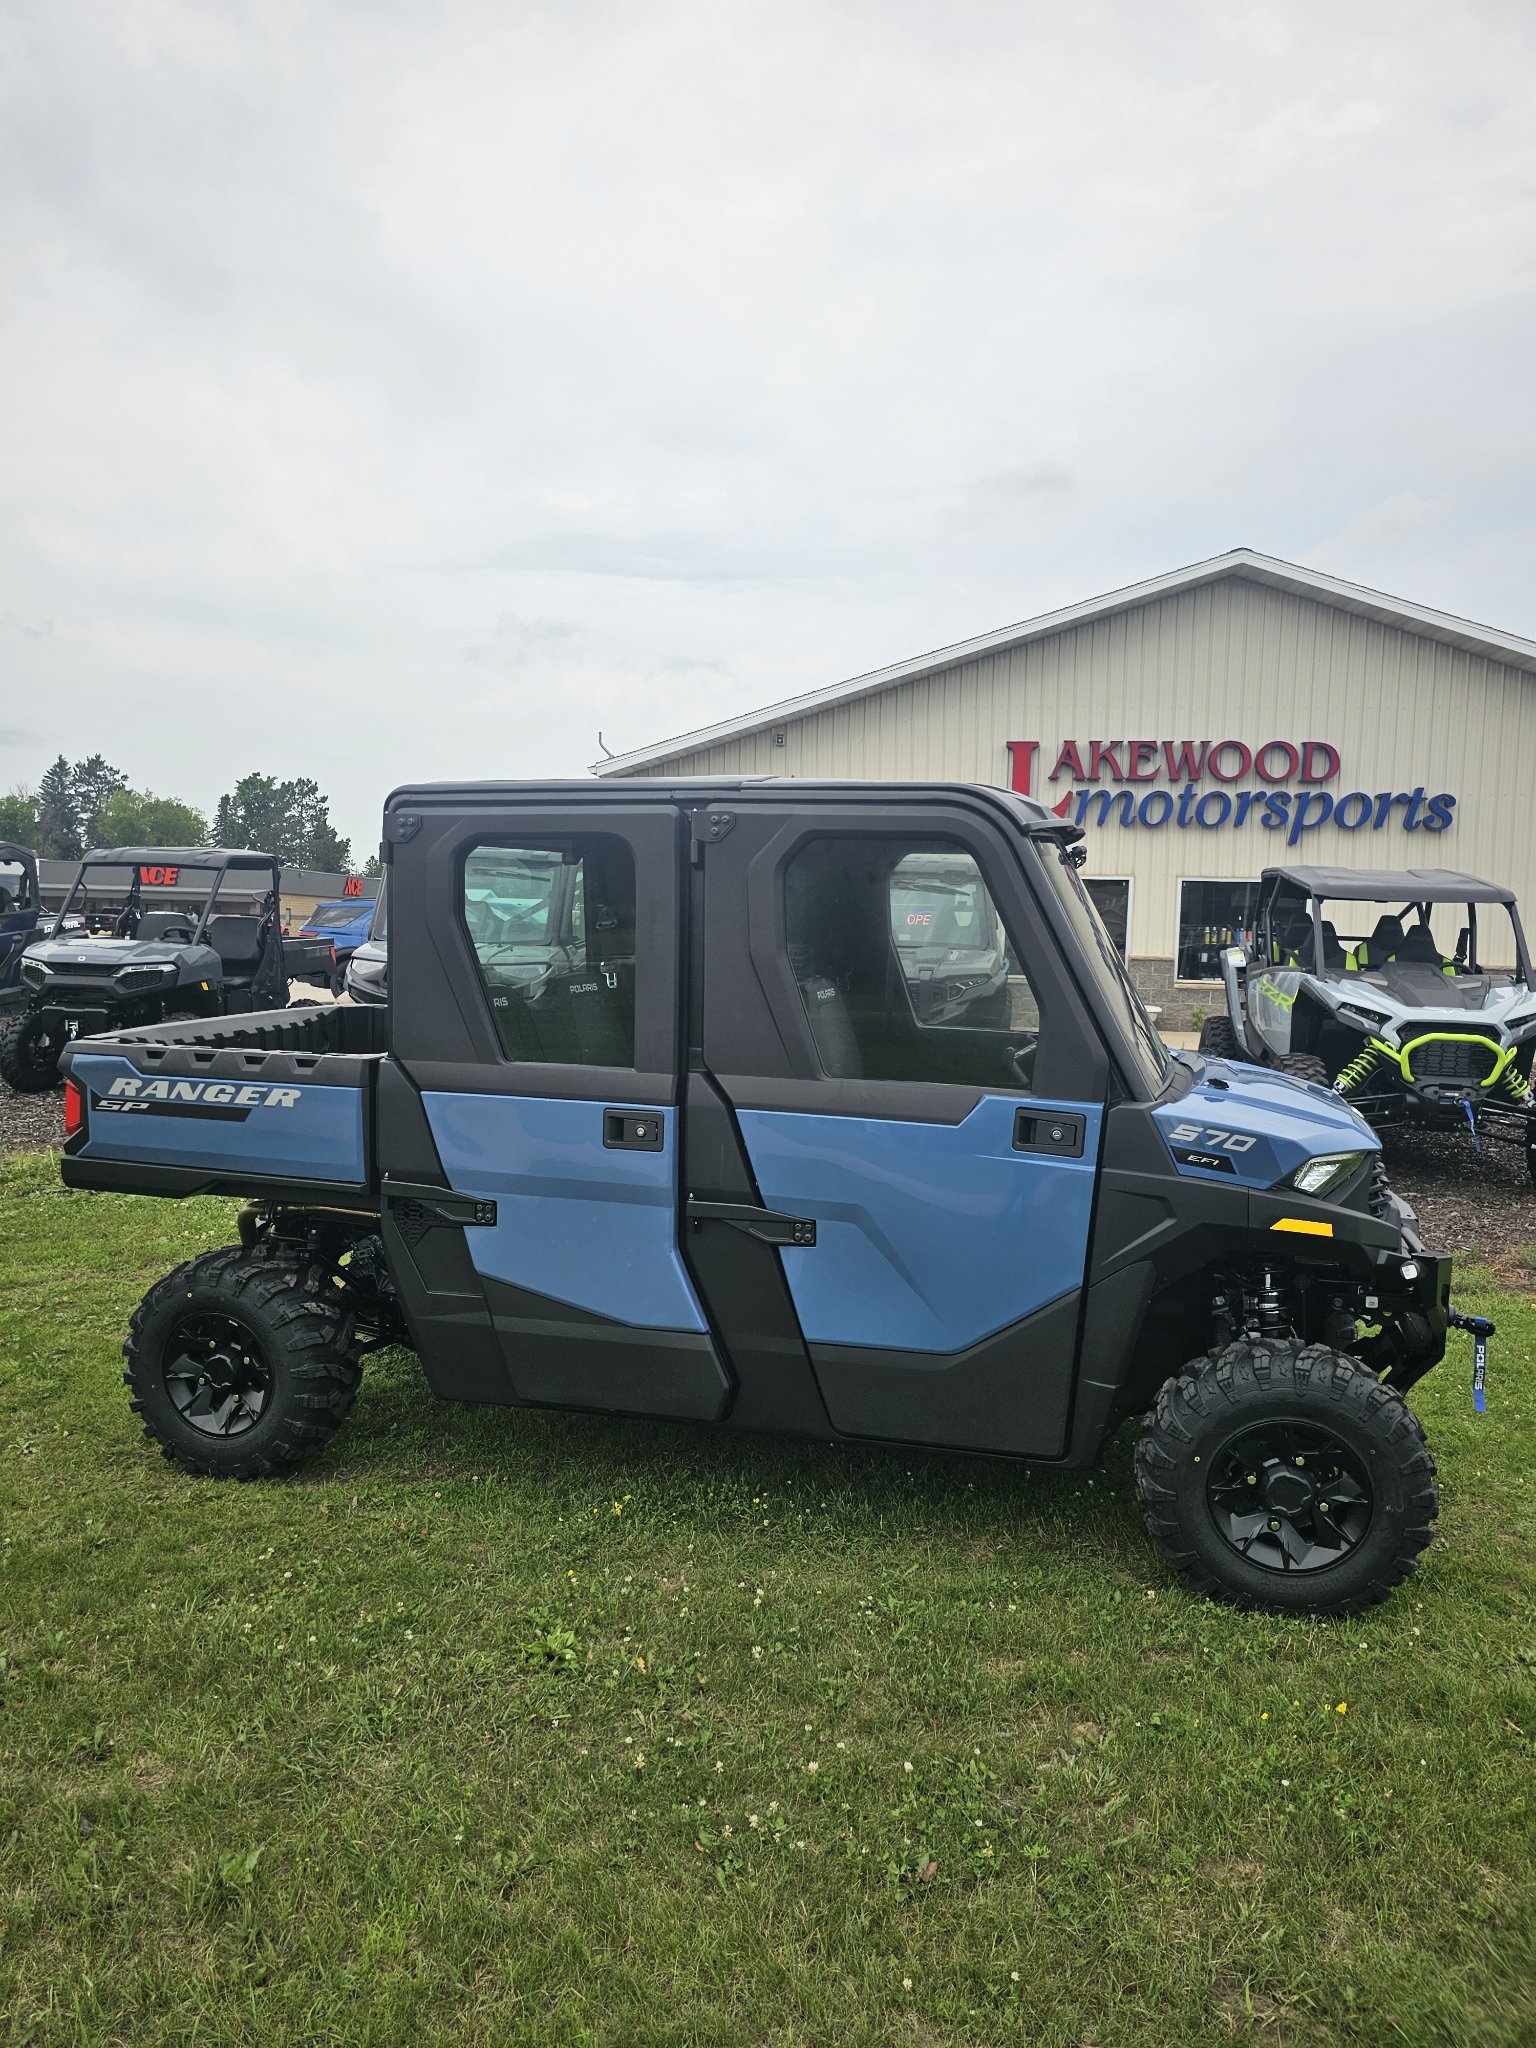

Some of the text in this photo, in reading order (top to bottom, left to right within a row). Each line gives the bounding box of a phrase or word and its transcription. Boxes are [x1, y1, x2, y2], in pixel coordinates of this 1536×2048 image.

[1006, 740, 1341, 819] LAKEWOOD
[1074, 783, 1457, 847] motorsports
[343, 877, 362, 896] ACE
[43, 920, 81, 934] GEERAL
[907, 914, 933, 926] OPE
[569, 982, 599, 994] POLARIS
[107, 1077, 302, 1108] RANGER
[95, 1099, 150, 1112] SP
[1168, 1123, 1257, 1152] 570
[1187, 1154, 1220, 1166] EFI
[1474, 1344, 1485, 1390] POLARIS
